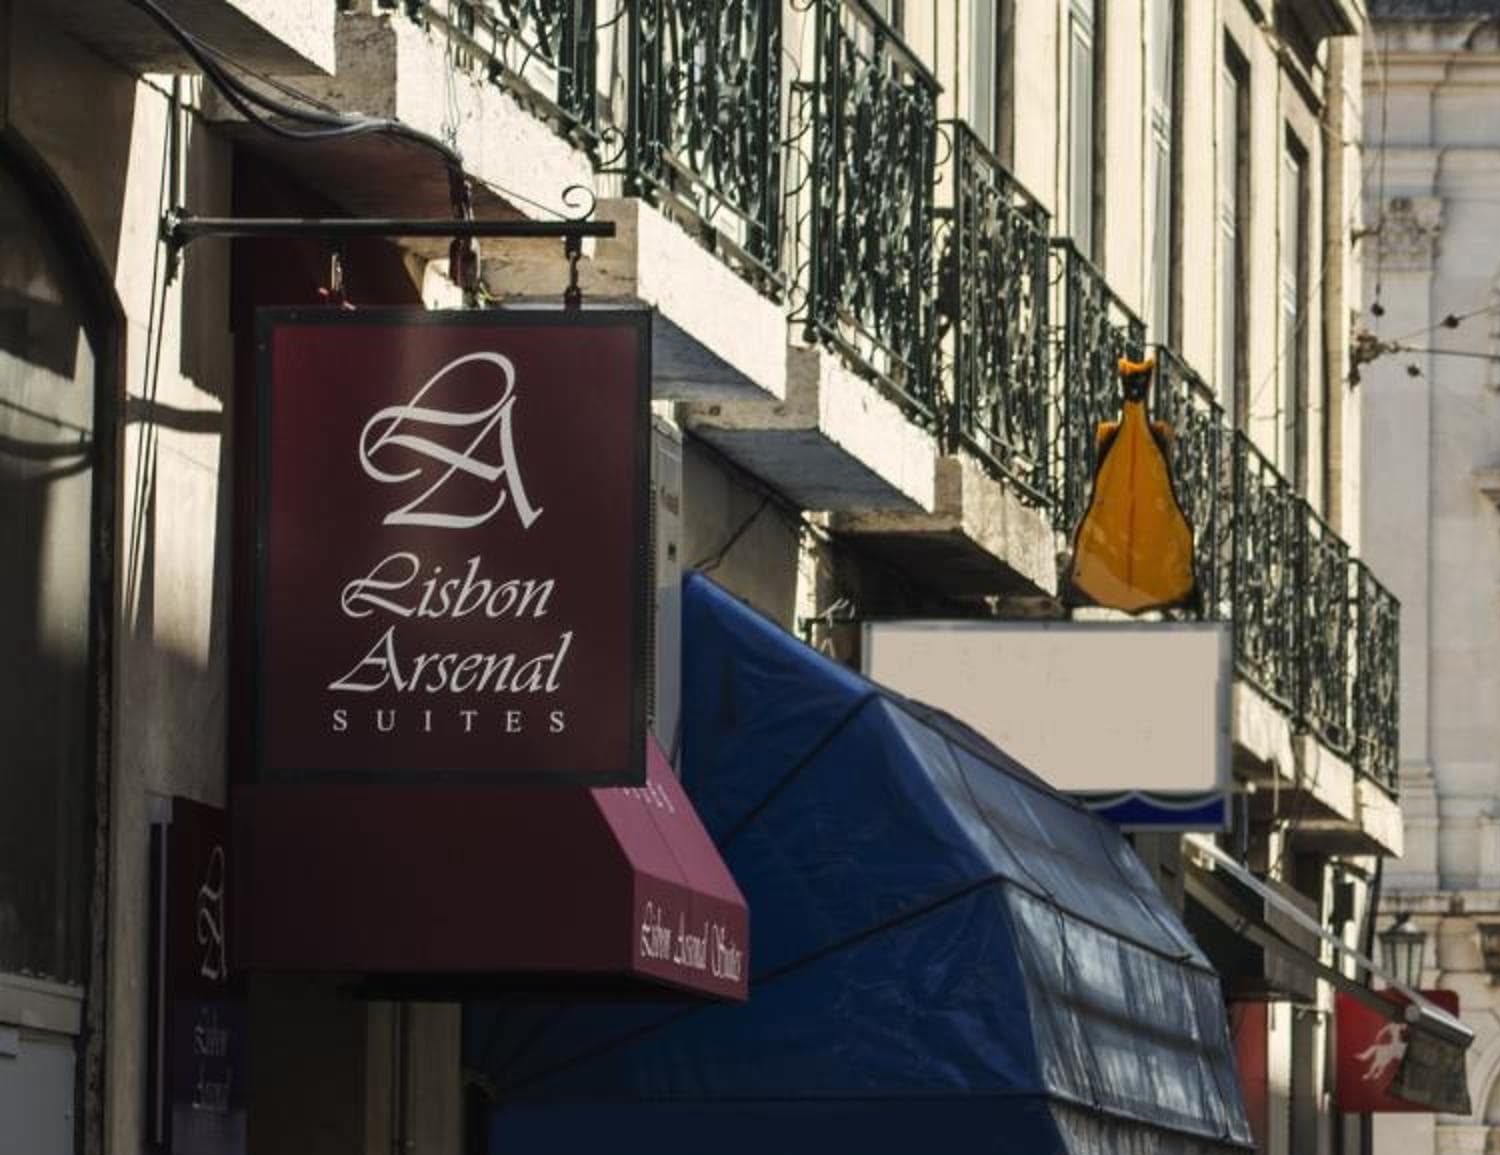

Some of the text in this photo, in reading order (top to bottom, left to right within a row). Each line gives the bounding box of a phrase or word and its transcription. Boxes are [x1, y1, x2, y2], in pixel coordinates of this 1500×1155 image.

[341, 551, 555, 618] Lisbon
[329, 625, 573, 693] Arsenal
[333, 710, 565, 733] SUITES
